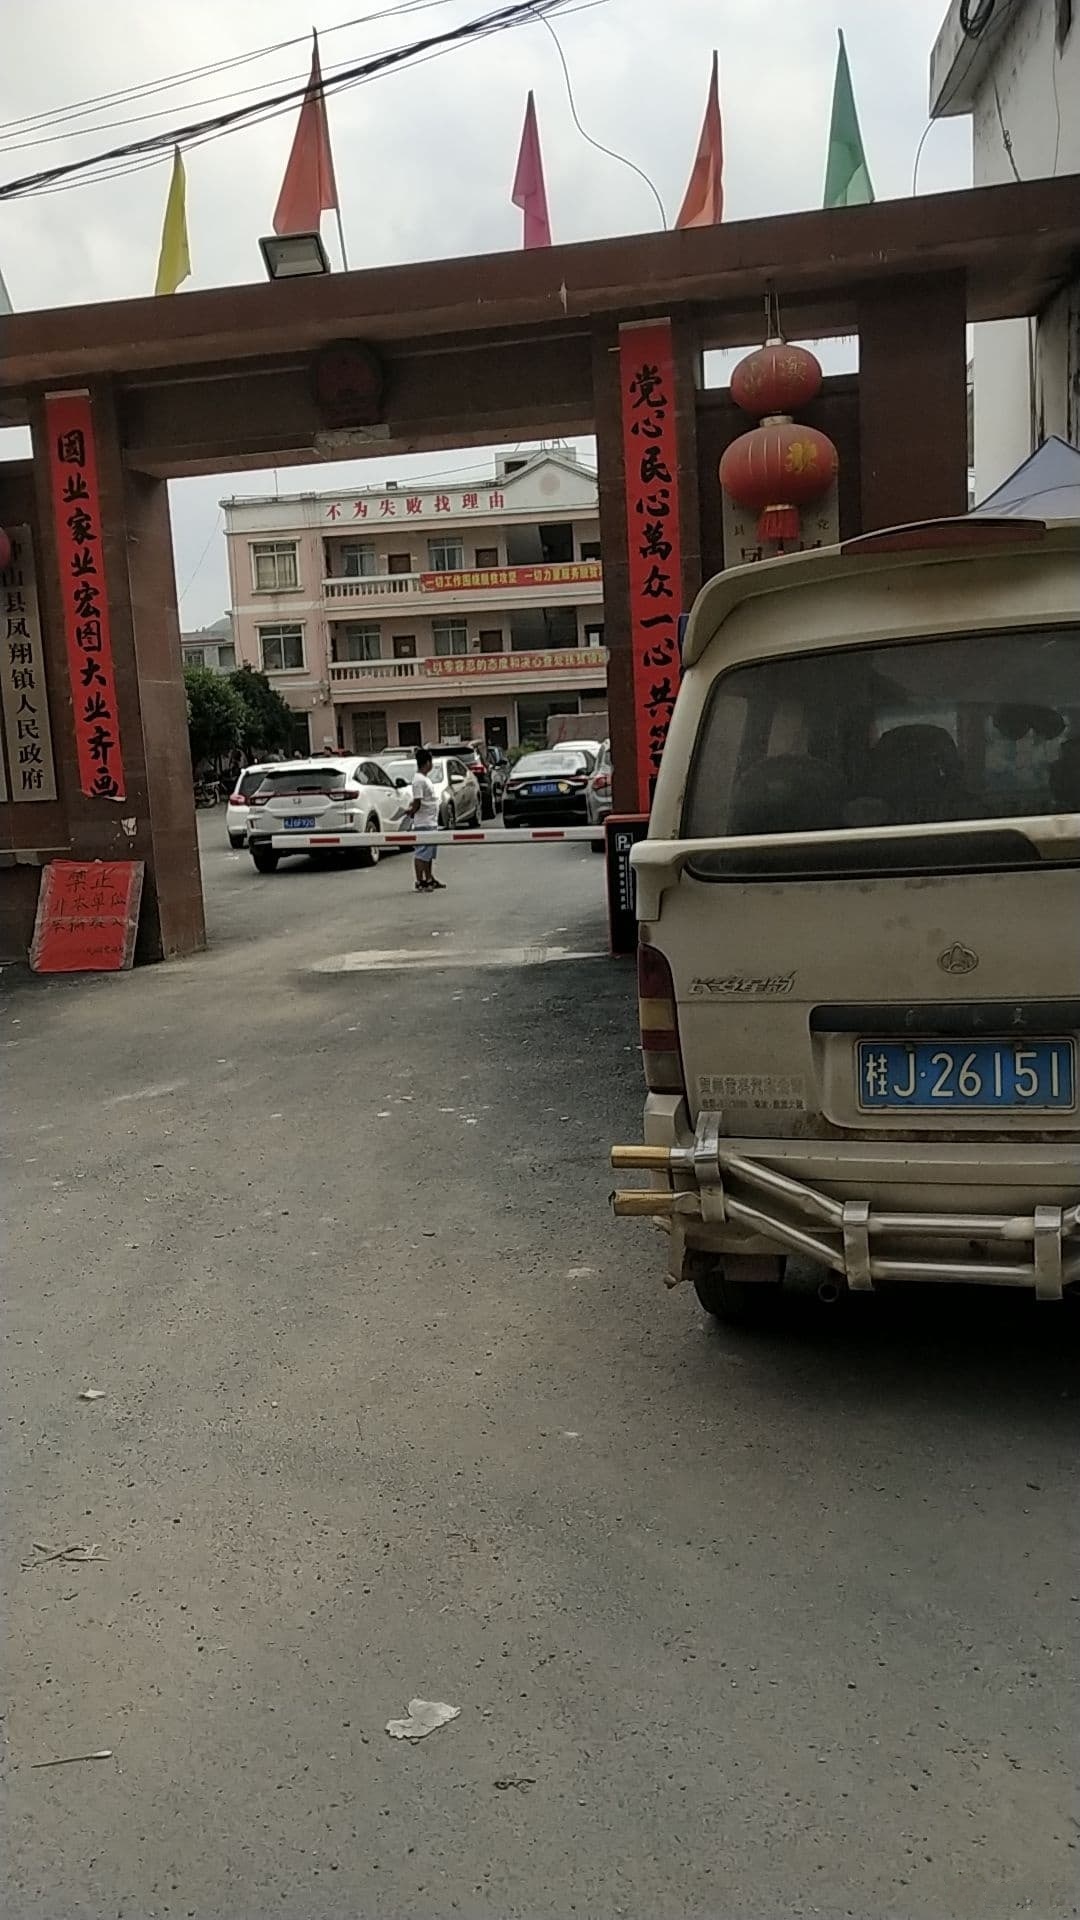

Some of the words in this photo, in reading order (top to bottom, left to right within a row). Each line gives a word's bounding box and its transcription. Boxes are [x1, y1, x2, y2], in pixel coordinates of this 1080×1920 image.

[326, 490, 506, 520] 不为失败找理由
